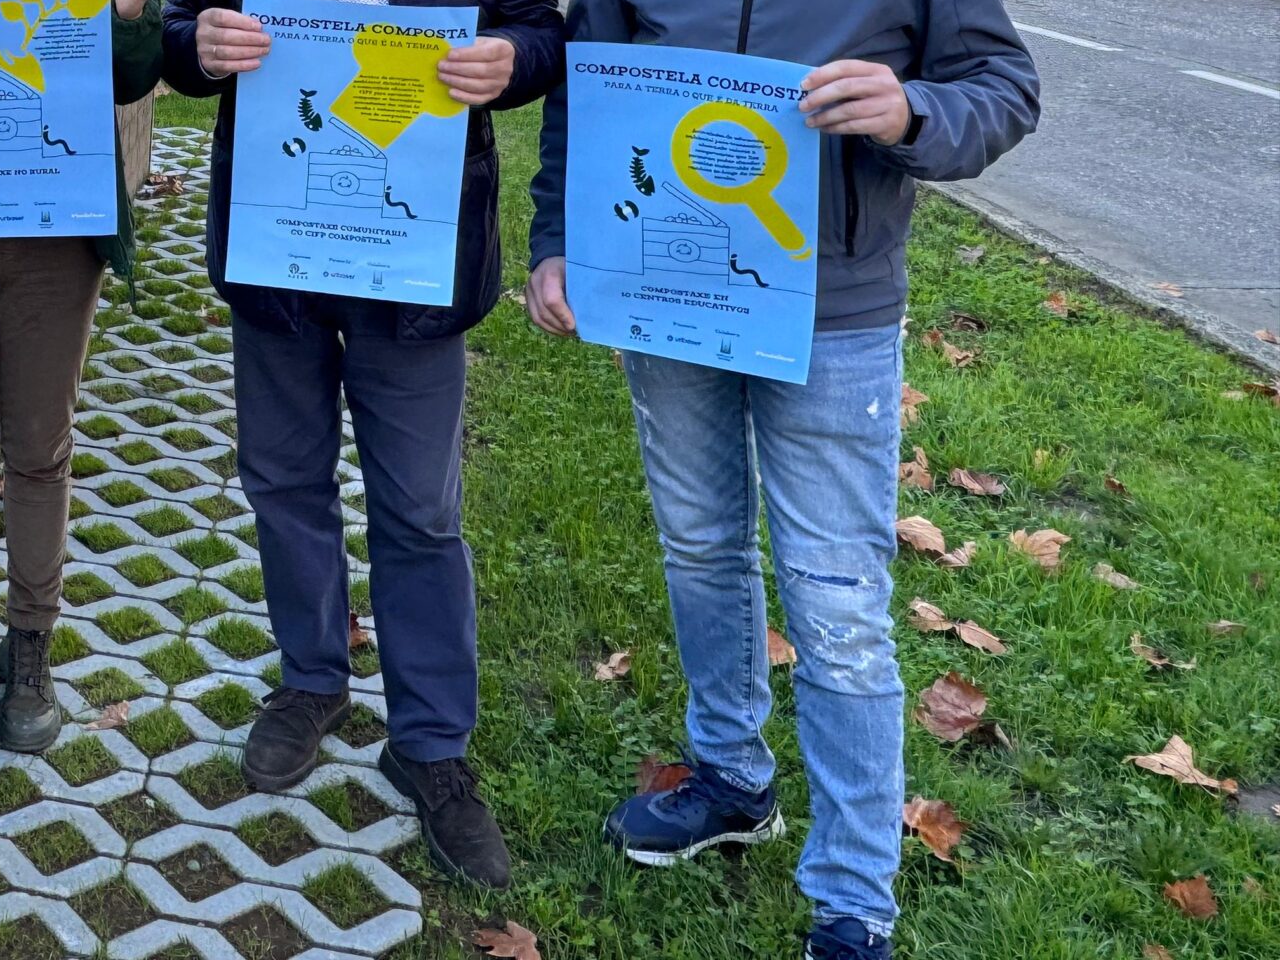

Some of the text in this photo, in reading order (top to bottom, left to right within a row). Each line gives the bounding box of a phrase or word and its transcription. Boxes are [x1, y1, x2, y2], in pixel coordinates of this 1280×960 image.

[274, 31, 301, 40] PARA
[312, 34, 345, 43] TERRA
[357, 38, 379, 47] QUE
[390, 40, 404, 49] DA
[406, 41, 440, 51] TERRA
[371, 24, 468, 39] COMPOSTA
[575, 63, 702, 85] COMPOSTELA
[604, 81, 632, 91] PARA
[645, 85, 680, 96] TERRA
[682, 90, 690, 98] O
[692, 91, 713, 102] QUE
[726, 97, 740, 106] DA
[741, 100, 779, 113] TERRA
[29, 168, 60, 176] RURAL
[276, 218, 408, 238] COMPOSTAXE COMUNITARIA
[328, 233, 391, 245] COMPOSTELA
[641, 285, 711, 299] COMPOSTAXE
[633, 293, 682, 304] CENTROS
[684, 299, 750, 314] EDUCATIVOS
